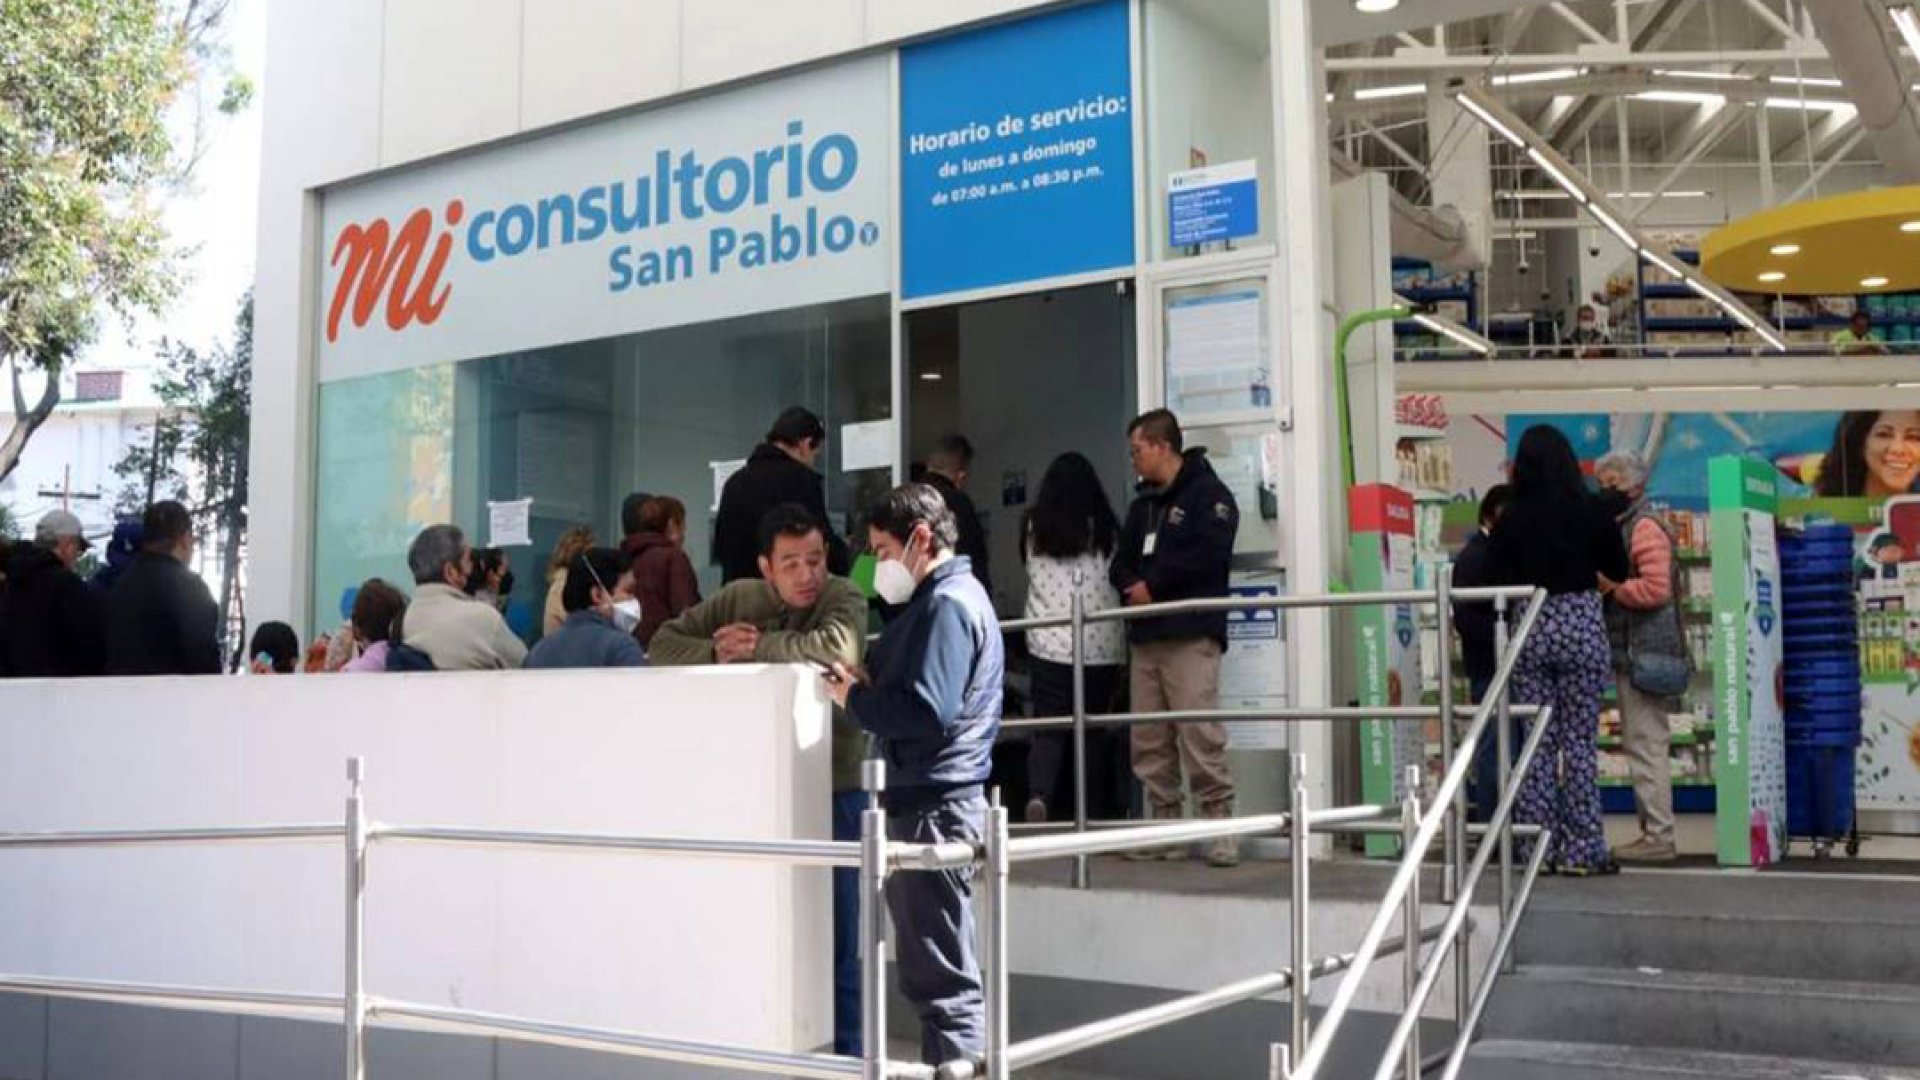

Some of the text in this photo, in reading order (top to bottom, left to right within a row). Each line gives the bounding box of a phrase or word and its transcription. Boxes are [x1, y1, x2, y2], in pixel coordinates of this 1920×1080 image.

[910, 96, 1126, 154] Horario de servicio:
[938, 137, 1097, 178] de lunes a domingo
[467, 120, 859, 262] consultorio
[931, 190, 948, 206] de
[951, 185, 987, 202] 07:00
[990, 180, 1018, 195] a.m.
[1021, 178, 1030, 189] a
[1073, 165, 1104, 183] p.m.
[609, 206, 855, 292] San Pablo
[1721, 627, 1739, 765] san pablo natural
